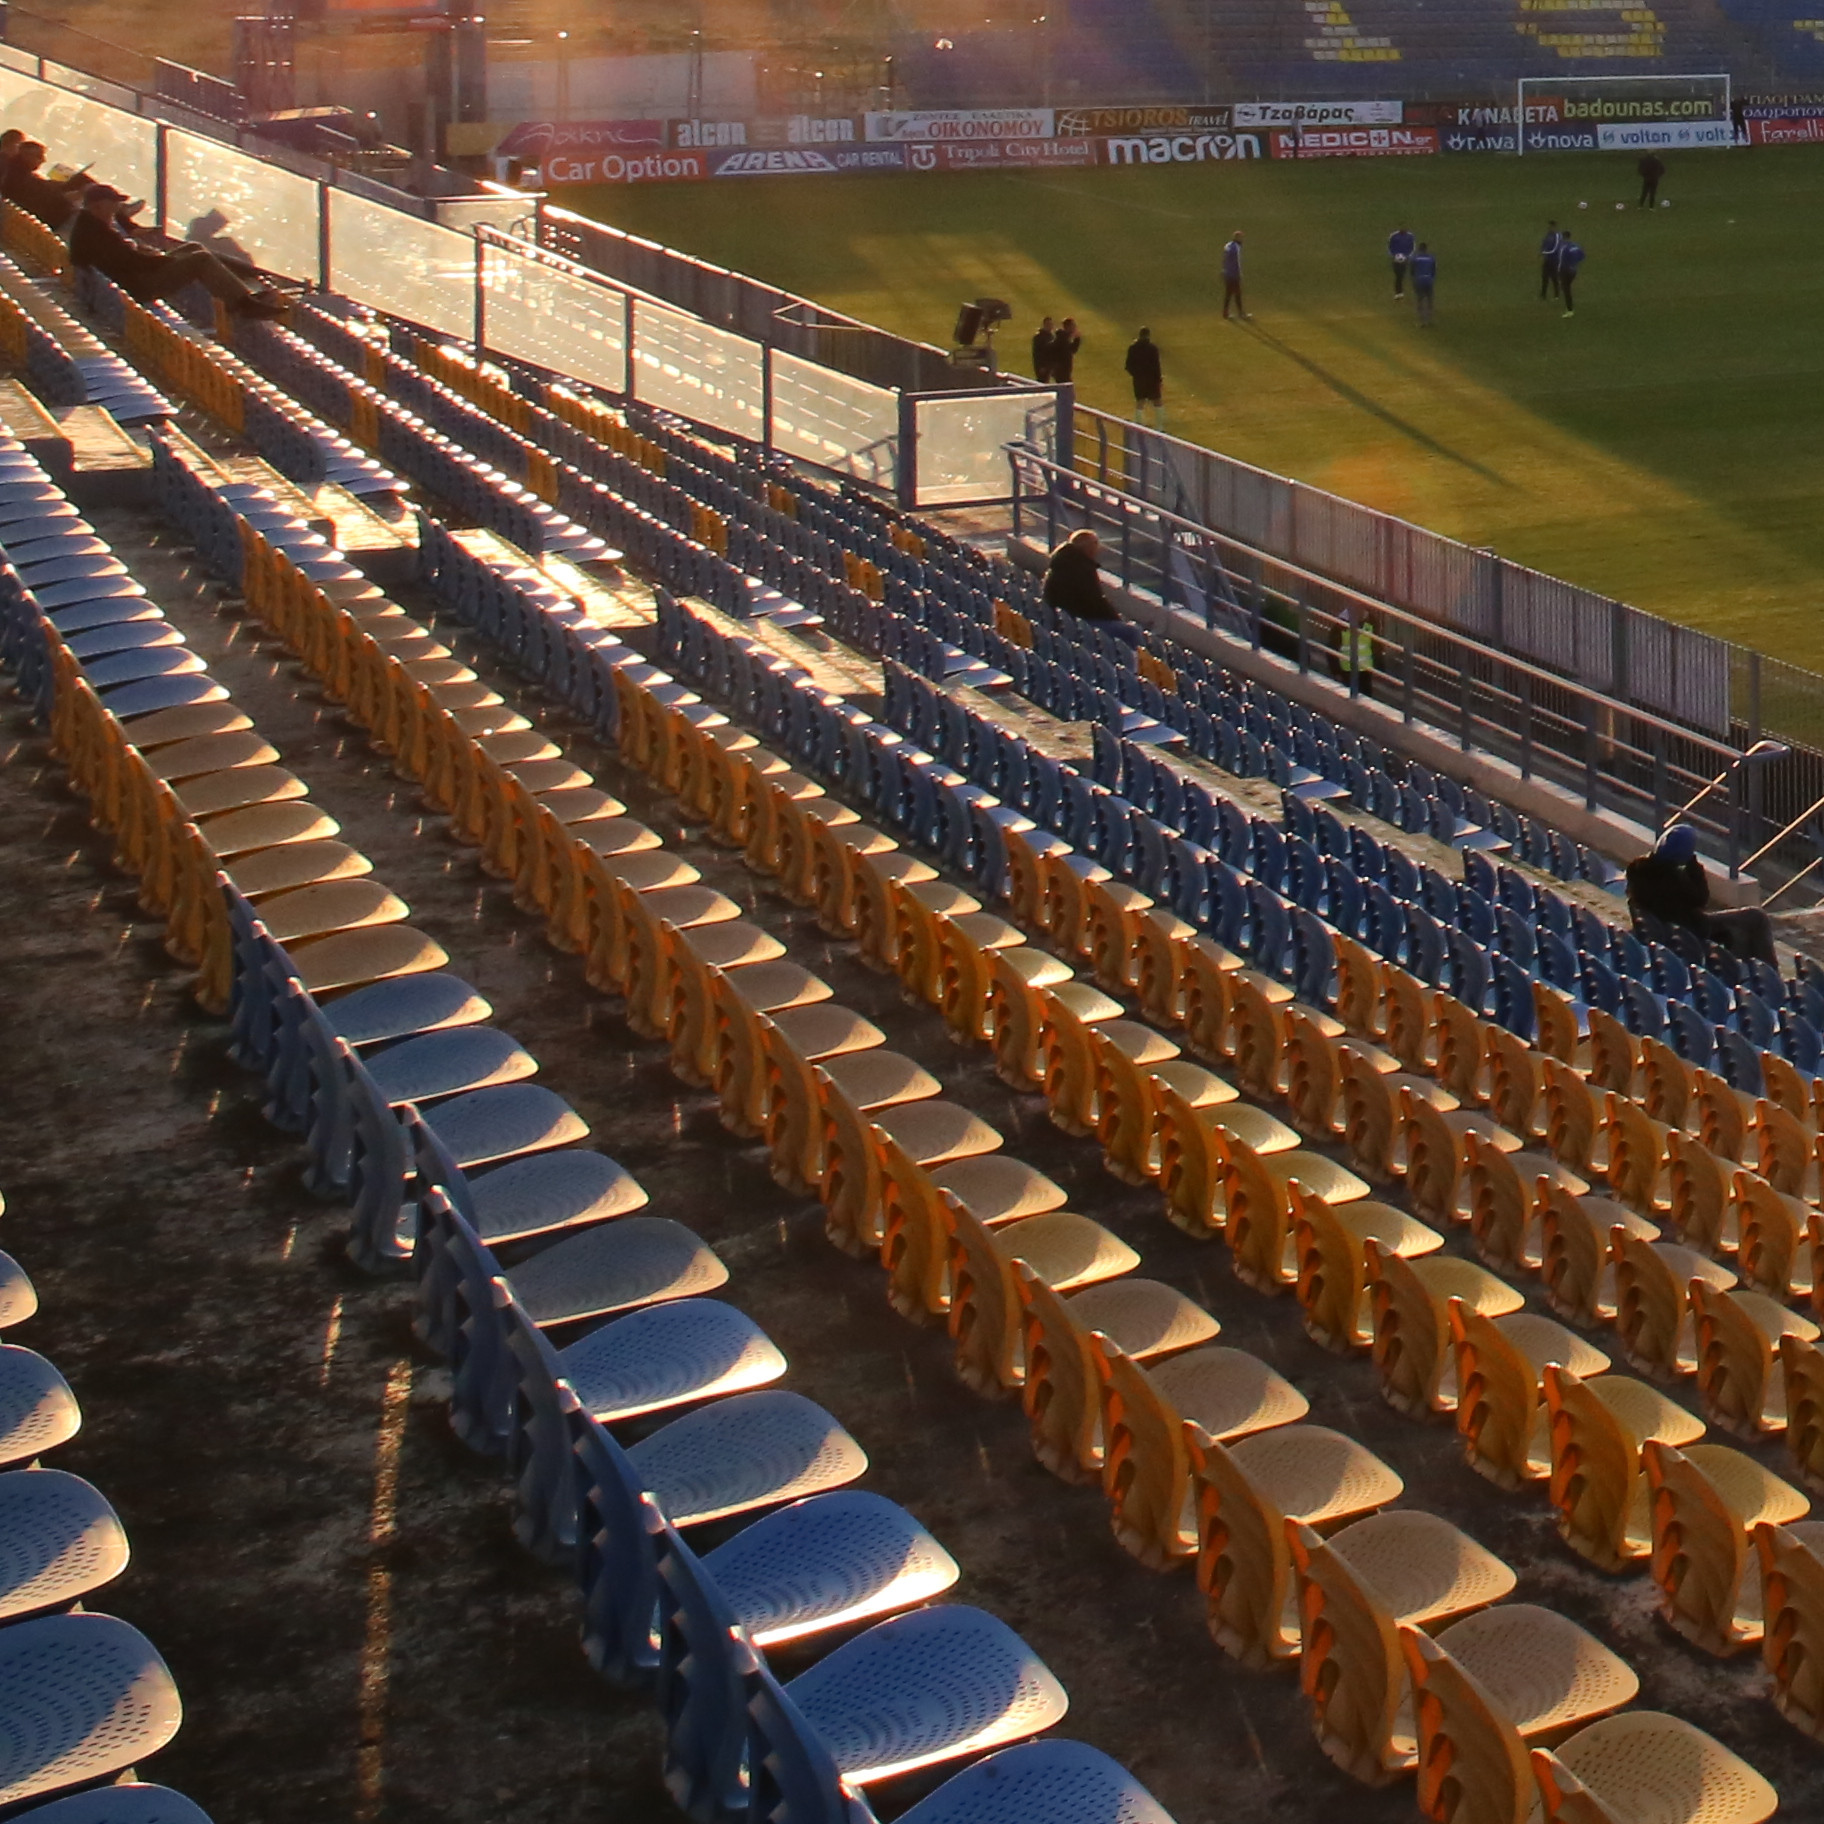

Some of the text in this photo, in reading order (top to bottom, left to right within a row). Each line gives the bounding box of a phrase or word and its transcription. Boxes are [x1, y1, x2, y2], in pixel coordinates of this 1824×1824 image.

[1091, 108, 1188, 127] TSIOROS
[1564, 98, 1713, 118] badounas.com
[677, 114, 855, 147] alcon alcon
[1549, 133, 1593, 149] nova
[1621, 127, 1742, 144] volton volt
[1761, 119, 1824, 143] farelli
[943, 141, 1089, 161] Tripoli City Hotel
[1107, 134, 1262, 165] macron
[550, 154, 700, 183] Car Option
[715, 150, 903, 175] ARENA CAR RENTAL
